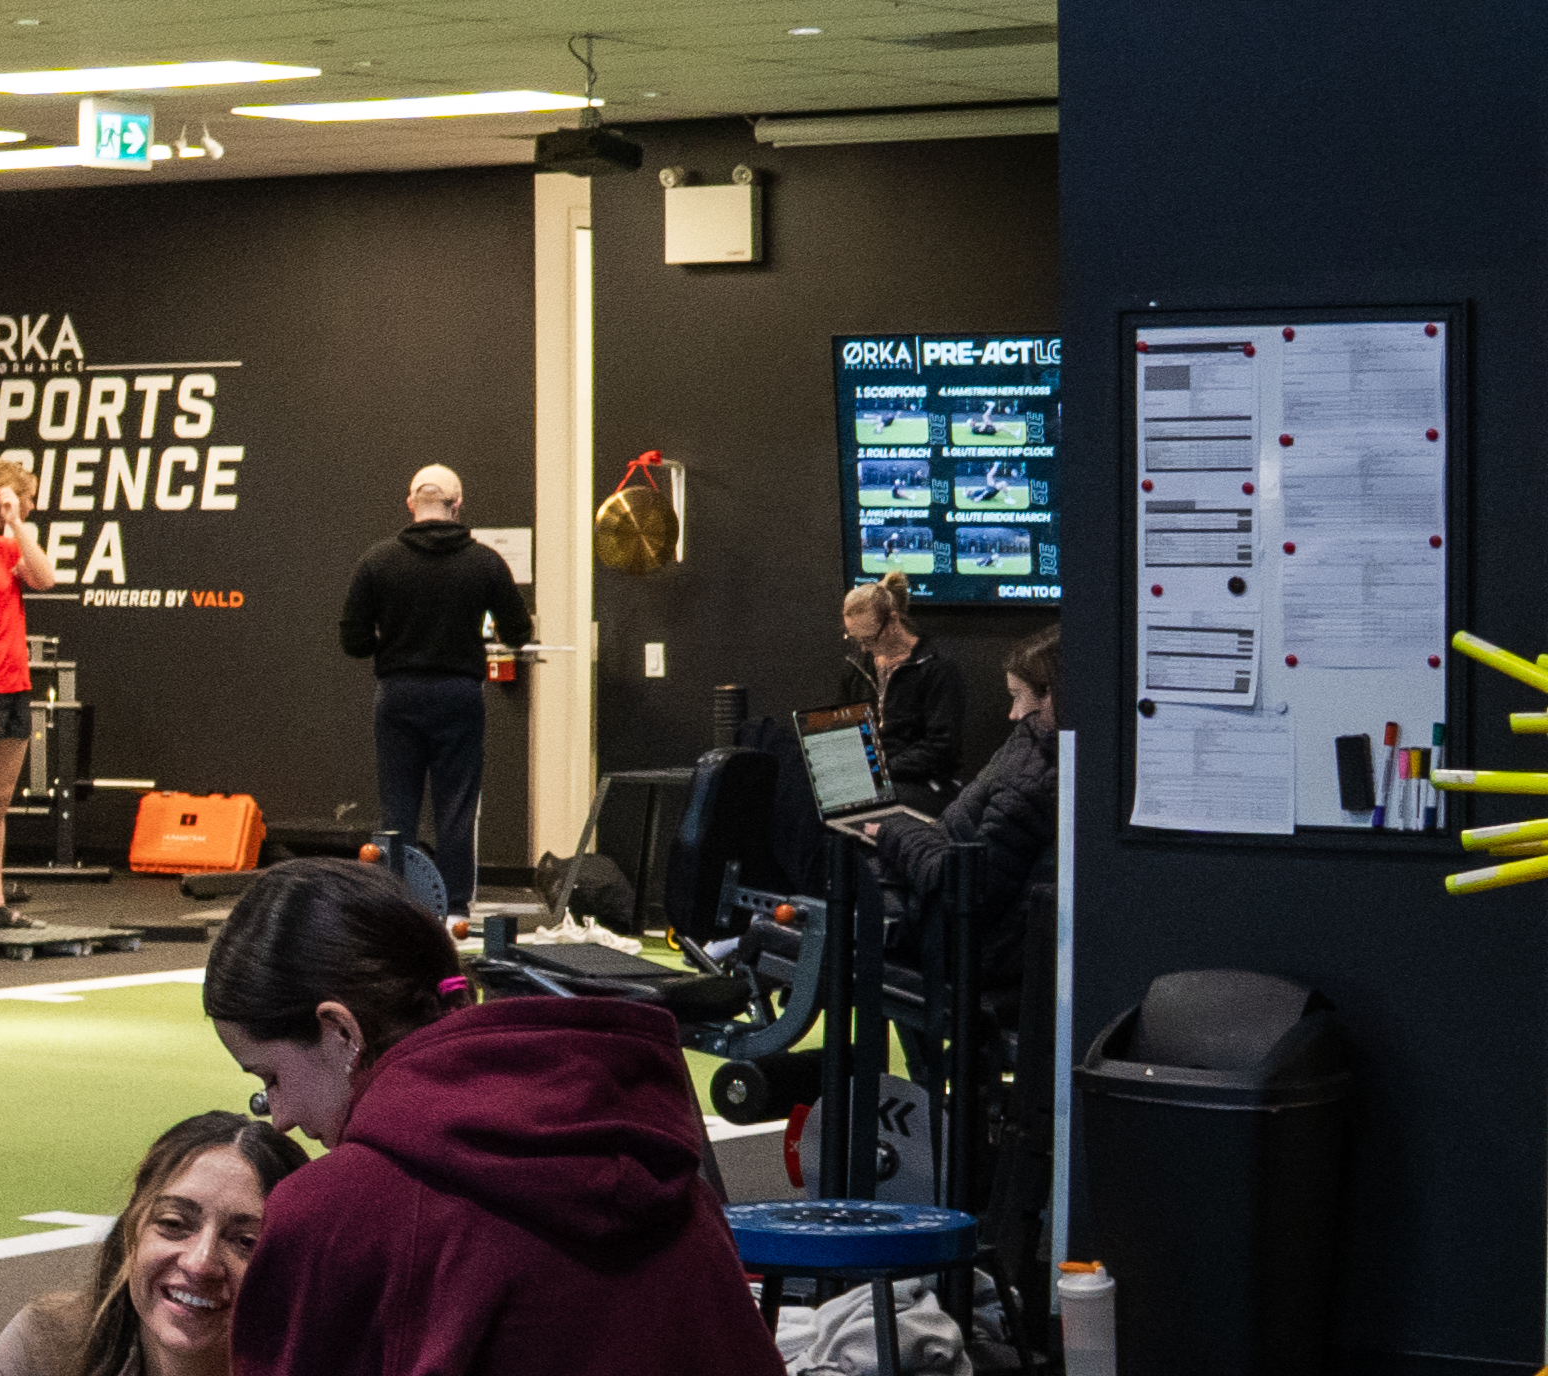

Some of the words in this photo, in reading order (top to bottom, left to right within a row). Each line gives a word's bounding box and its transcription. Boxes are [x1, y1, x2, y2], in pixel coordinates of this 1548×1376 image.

[843, 341, 912, 365] ØRKA
[864, 385, 927, 398] SCORPIONS
[898, 447, 931, 458] REACH
[1023, 447, 1054, 457] CLOCK
[1016, 511, 1051, 522] MARCH
[998, 585, 1032, 597] SCAN
[1033, 585, 1048, 597] TO
[83, 589, 161, 608] POWERED
[164, 589, 188, 608] BY
[191, 590, 245, 608] VALD
